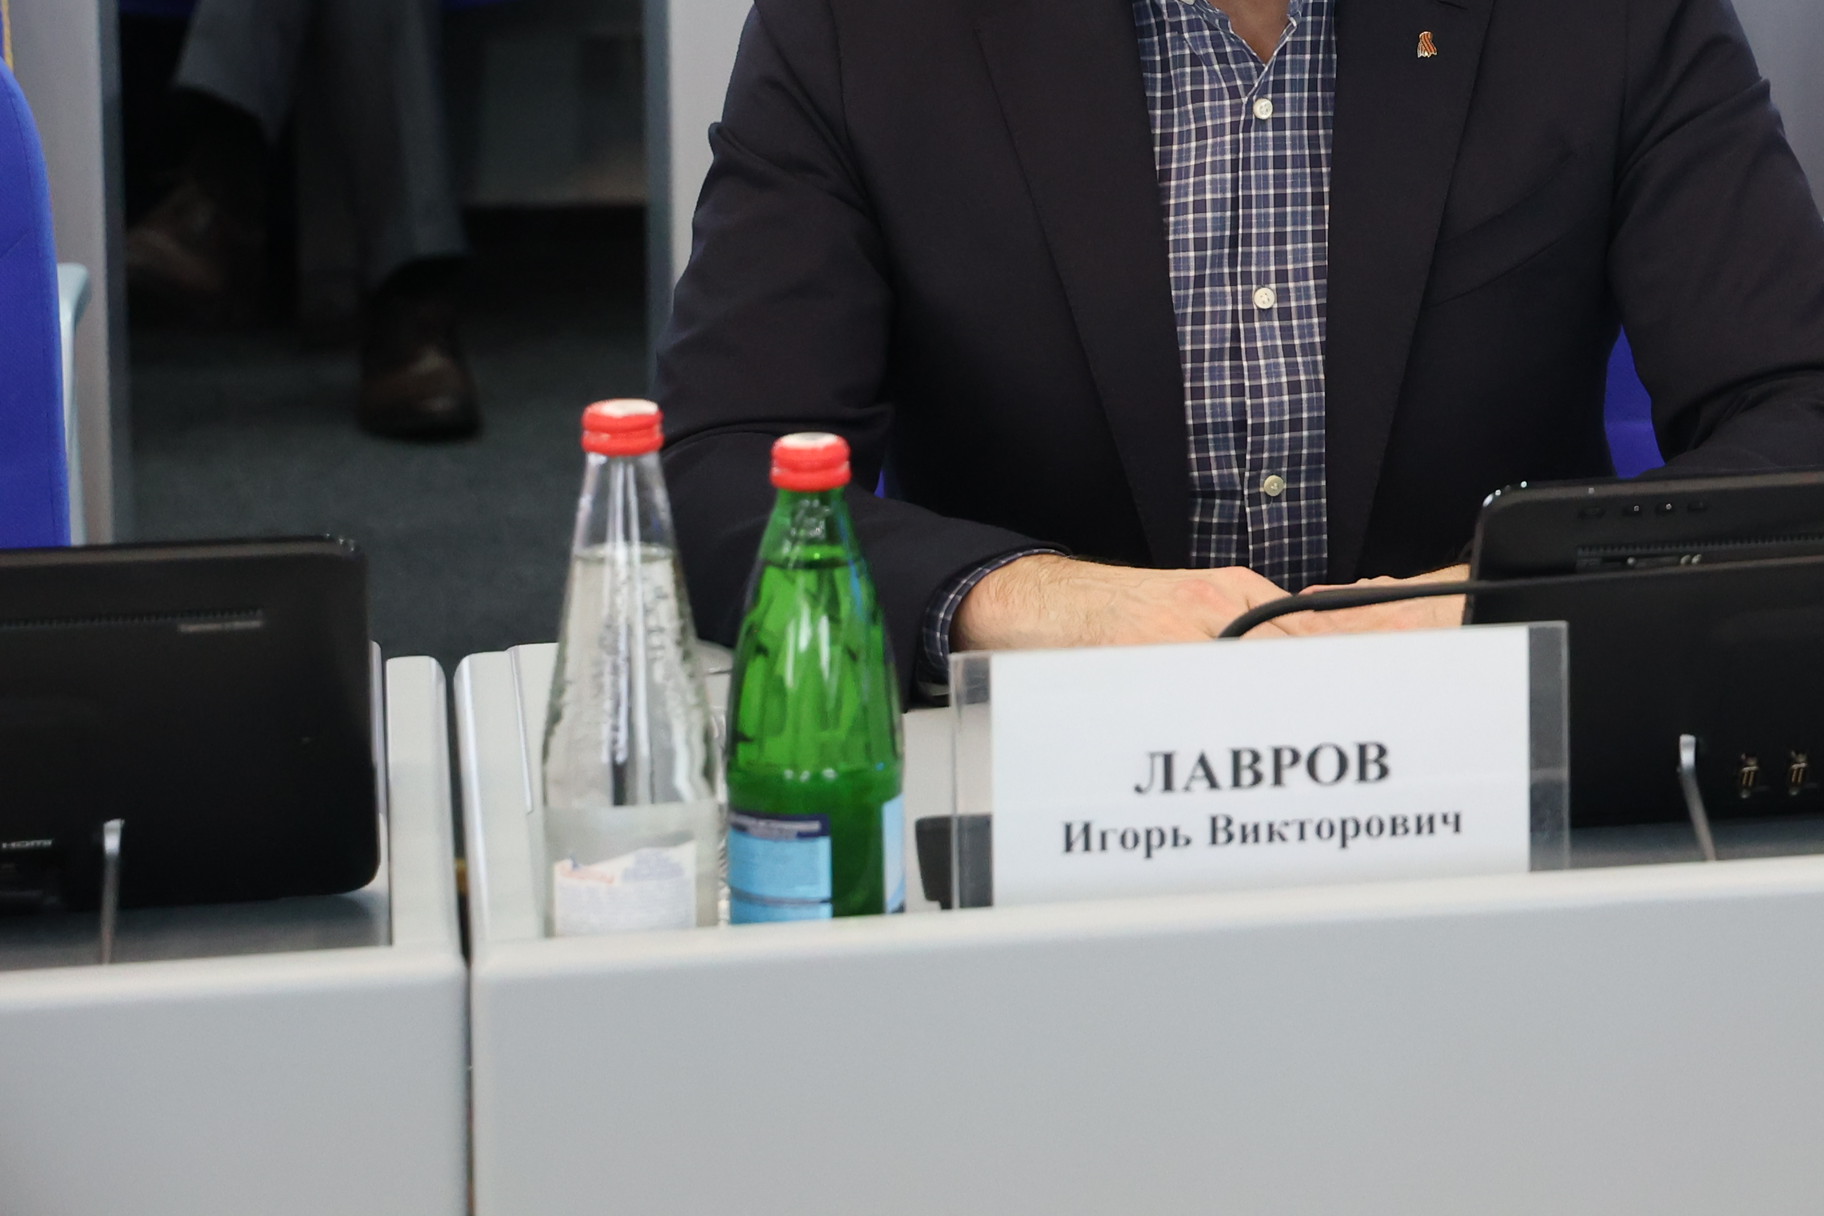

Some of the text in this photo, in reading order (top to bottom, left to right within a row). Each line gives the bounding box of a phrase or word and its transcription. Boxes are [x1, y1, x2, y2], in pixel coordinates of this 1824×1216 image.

[1133, 741, 1390, 795] ЛАВРОВ
[1062, 811, 1463, 859] Игорь Викторович
